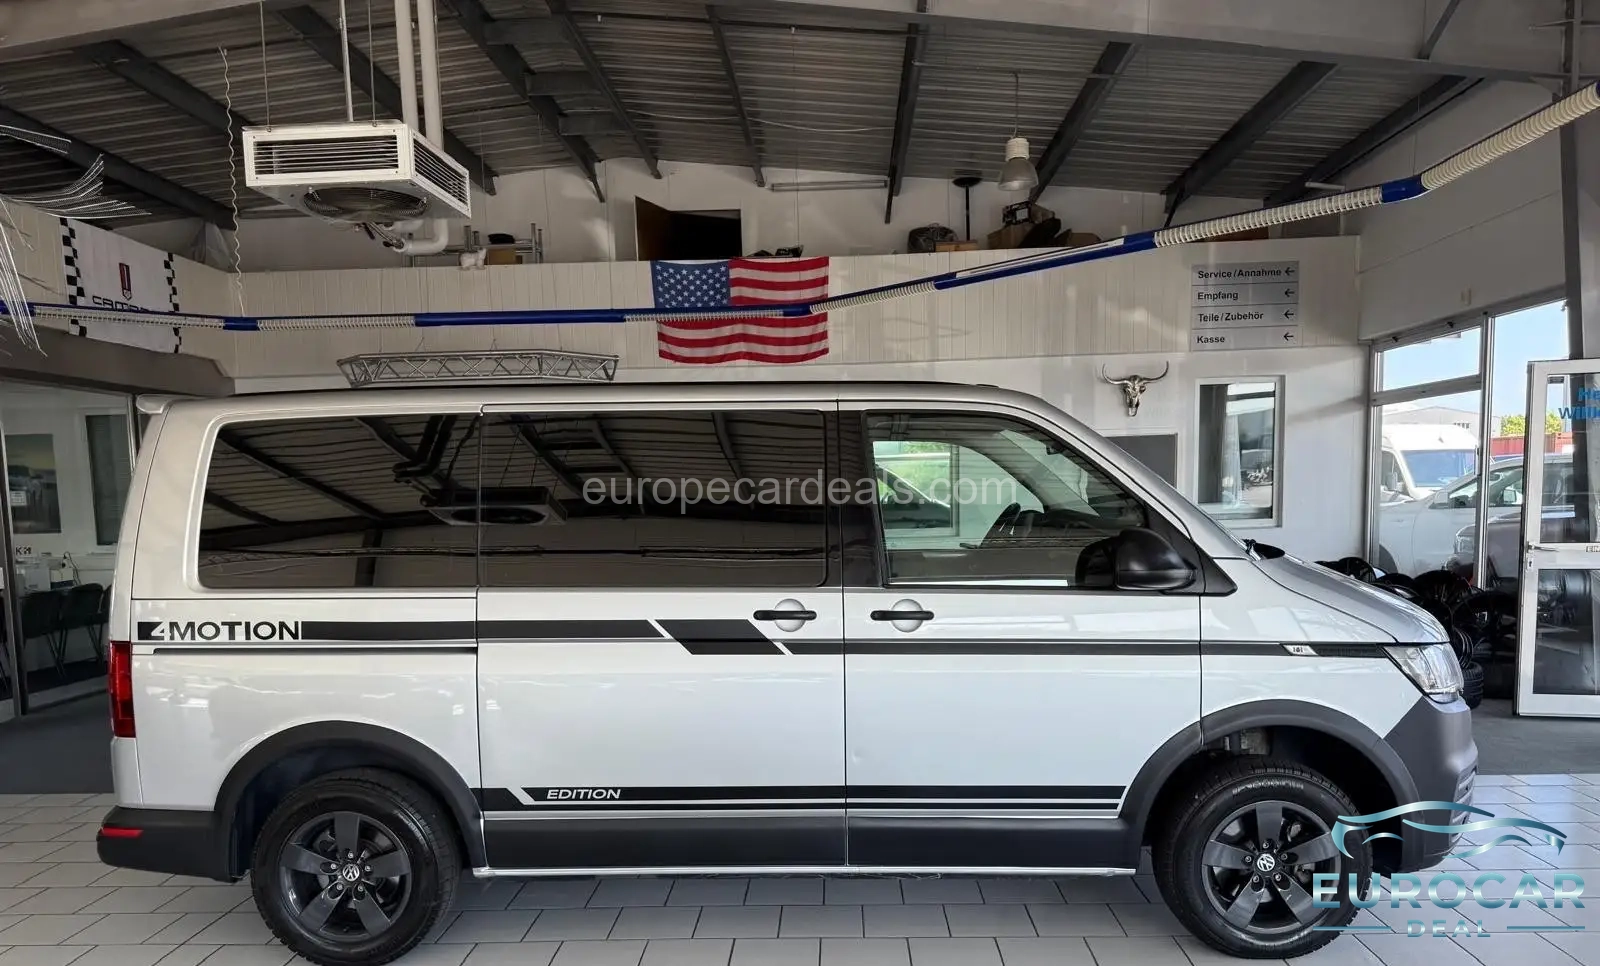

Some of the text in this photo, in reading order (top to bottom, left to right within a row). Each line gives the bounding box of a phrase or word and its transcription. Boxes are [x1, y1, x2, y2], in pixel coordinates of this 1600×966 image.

[1198, 268, 1281, 279] Service/Annahme
[1197, 291, 1239, 301] Empfang
[92, 295, 151, 313] CAMA
[1196, 335, 1225, 344] Kasse
[150, 621, 299, 641] 4MOTION
[546, 789, 621, 800] EDITION
